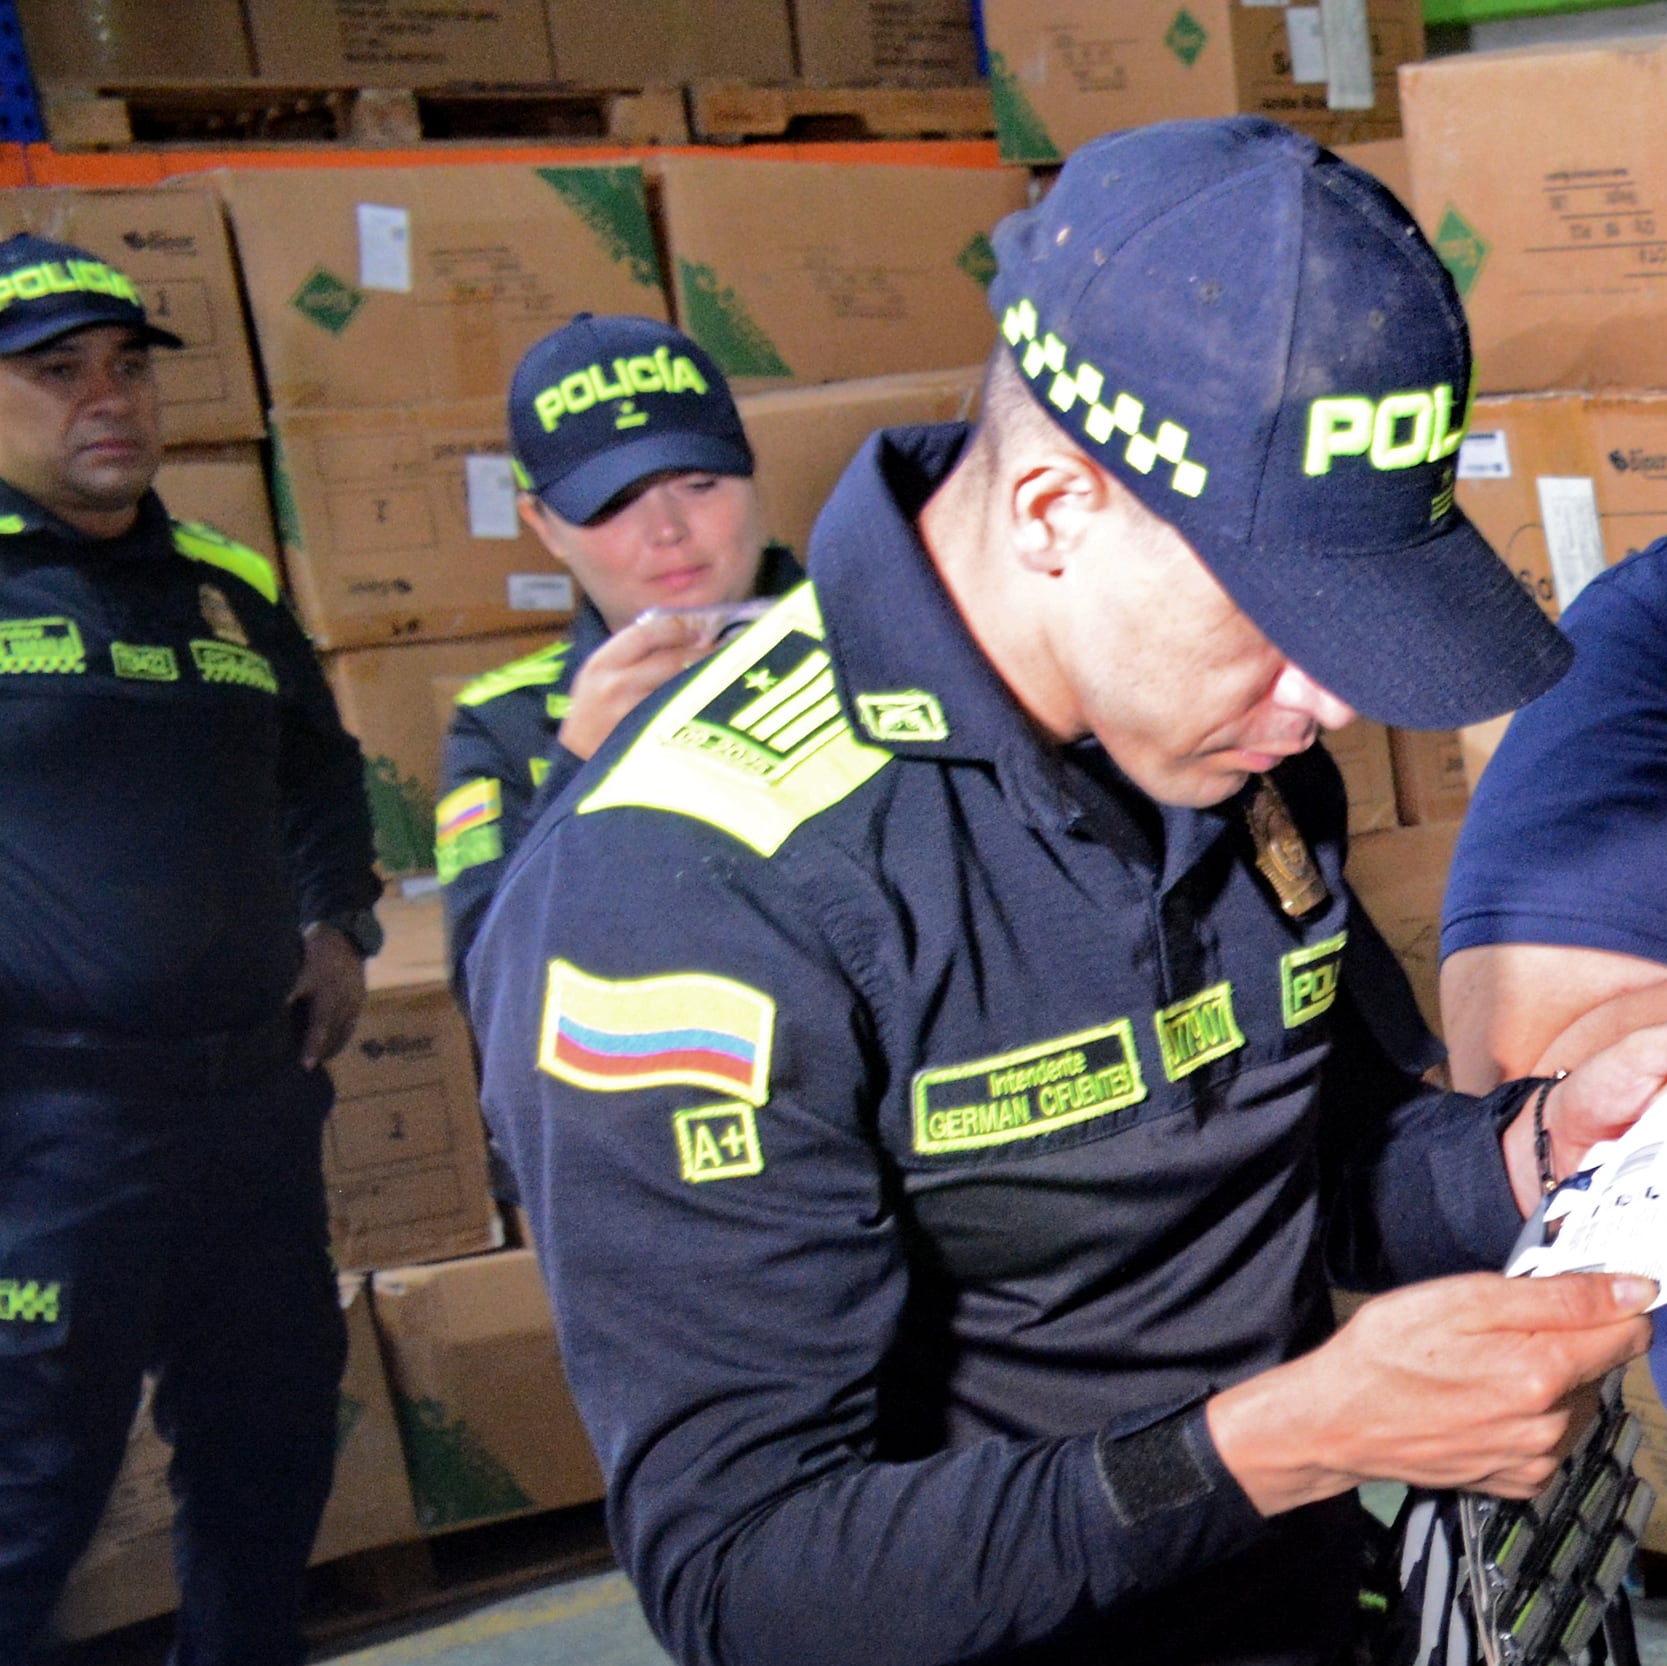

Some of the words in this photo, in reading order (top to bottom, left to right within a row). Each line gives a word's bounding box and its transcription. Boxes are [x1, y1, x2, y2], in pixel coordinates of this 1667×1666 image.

[533, 345, 709, 433] POLICÍA
[989, 1050, 1089, 1098] Intendente
[928, 1095, 1032, 1140] GERMAN
[693, 1122, 748, 1170] A+
